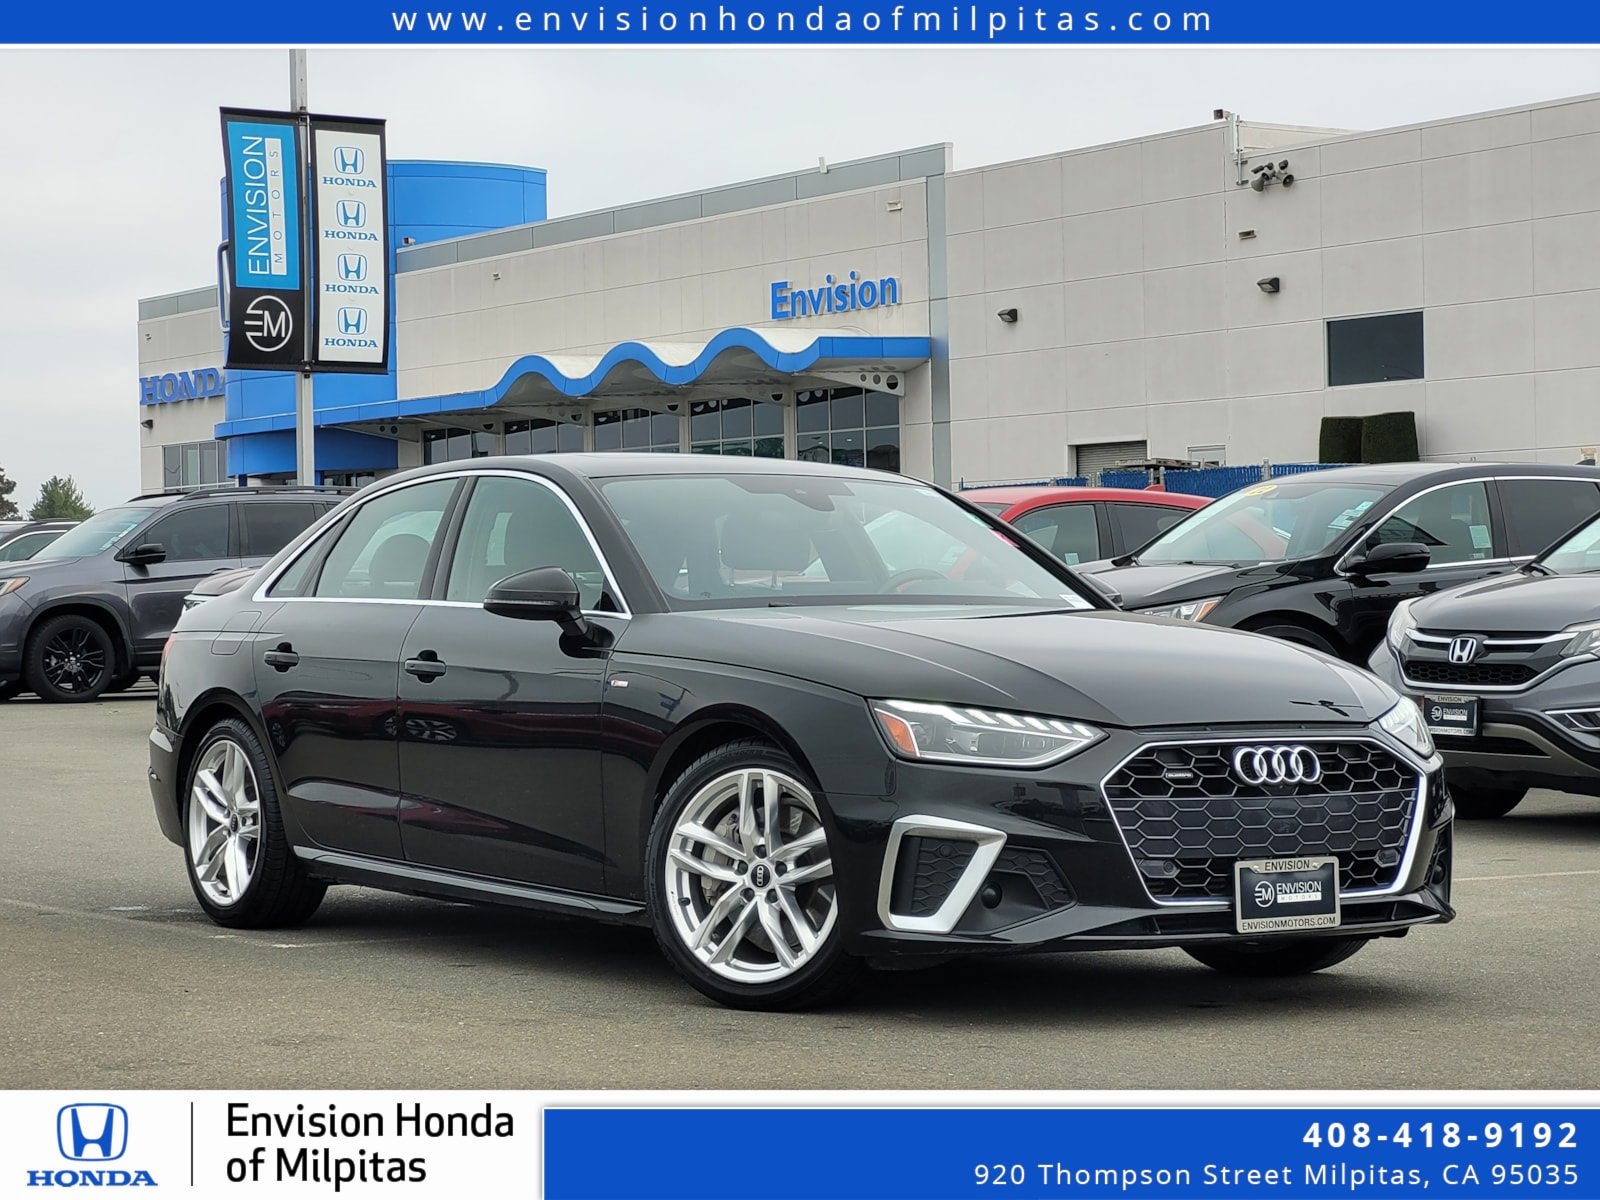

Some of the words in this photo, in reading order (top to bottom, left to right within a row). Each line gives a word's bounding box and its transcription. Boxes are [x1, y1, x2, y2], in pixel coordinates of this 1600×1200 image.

[322, 176, 377, 188] HONDA
[242, 135, 270, 276] ENVISION
[269, 150, 283, 264] MOTORS
[324, 230, 379, 241] HONDA
[325, 284, 379, 295] HONDA
[770, 270, 898, 320] Envision
[324, 338, 378, 348] HONDA
[1264, 860, 1310, 871] ENVISION
[1276, 881, 1322, 895] ENVISION
[1242, 917, 1336, 931] ENVISIONMOTORS.COM
